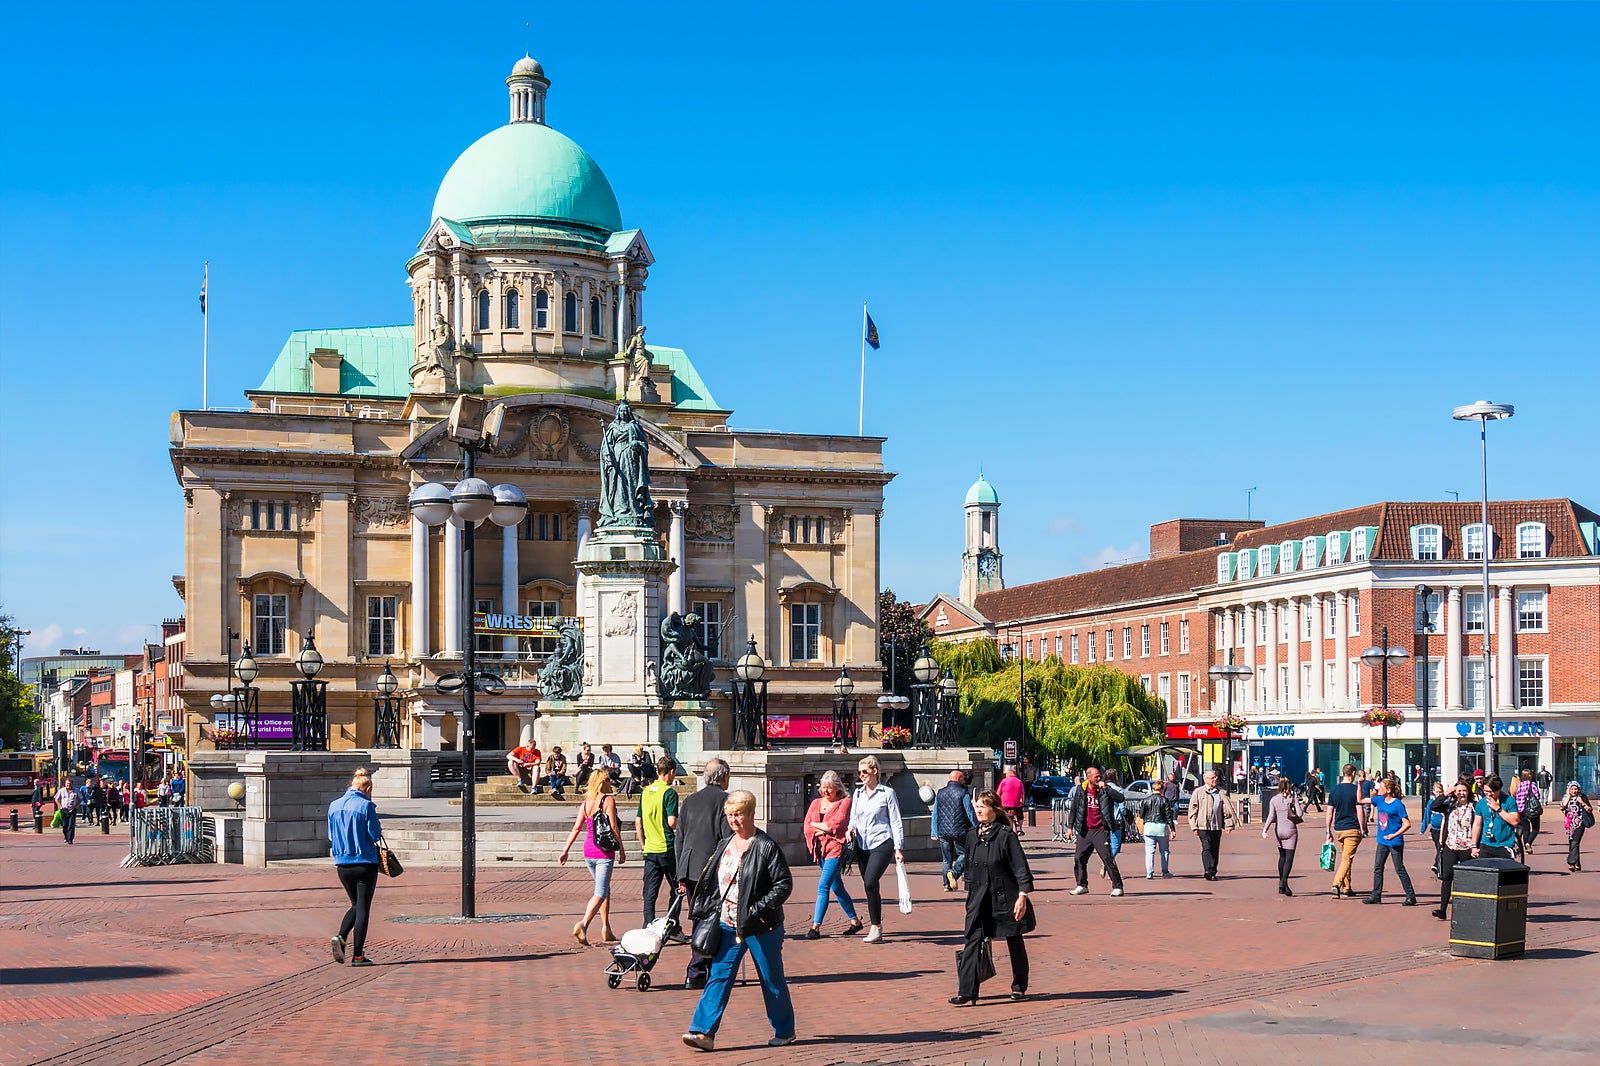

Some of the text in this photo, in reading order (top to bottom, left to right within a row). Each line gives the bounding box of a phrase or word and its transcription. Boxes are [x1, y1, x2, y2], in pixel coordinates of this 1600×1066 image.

[486, 613, 580, 630] WRESTLNG
[1195, 728, 1208, 736] money
[1264, 725, 1295, 737] BARCLAYS
[1475, 721, 1545, 736] BRCLAYS
